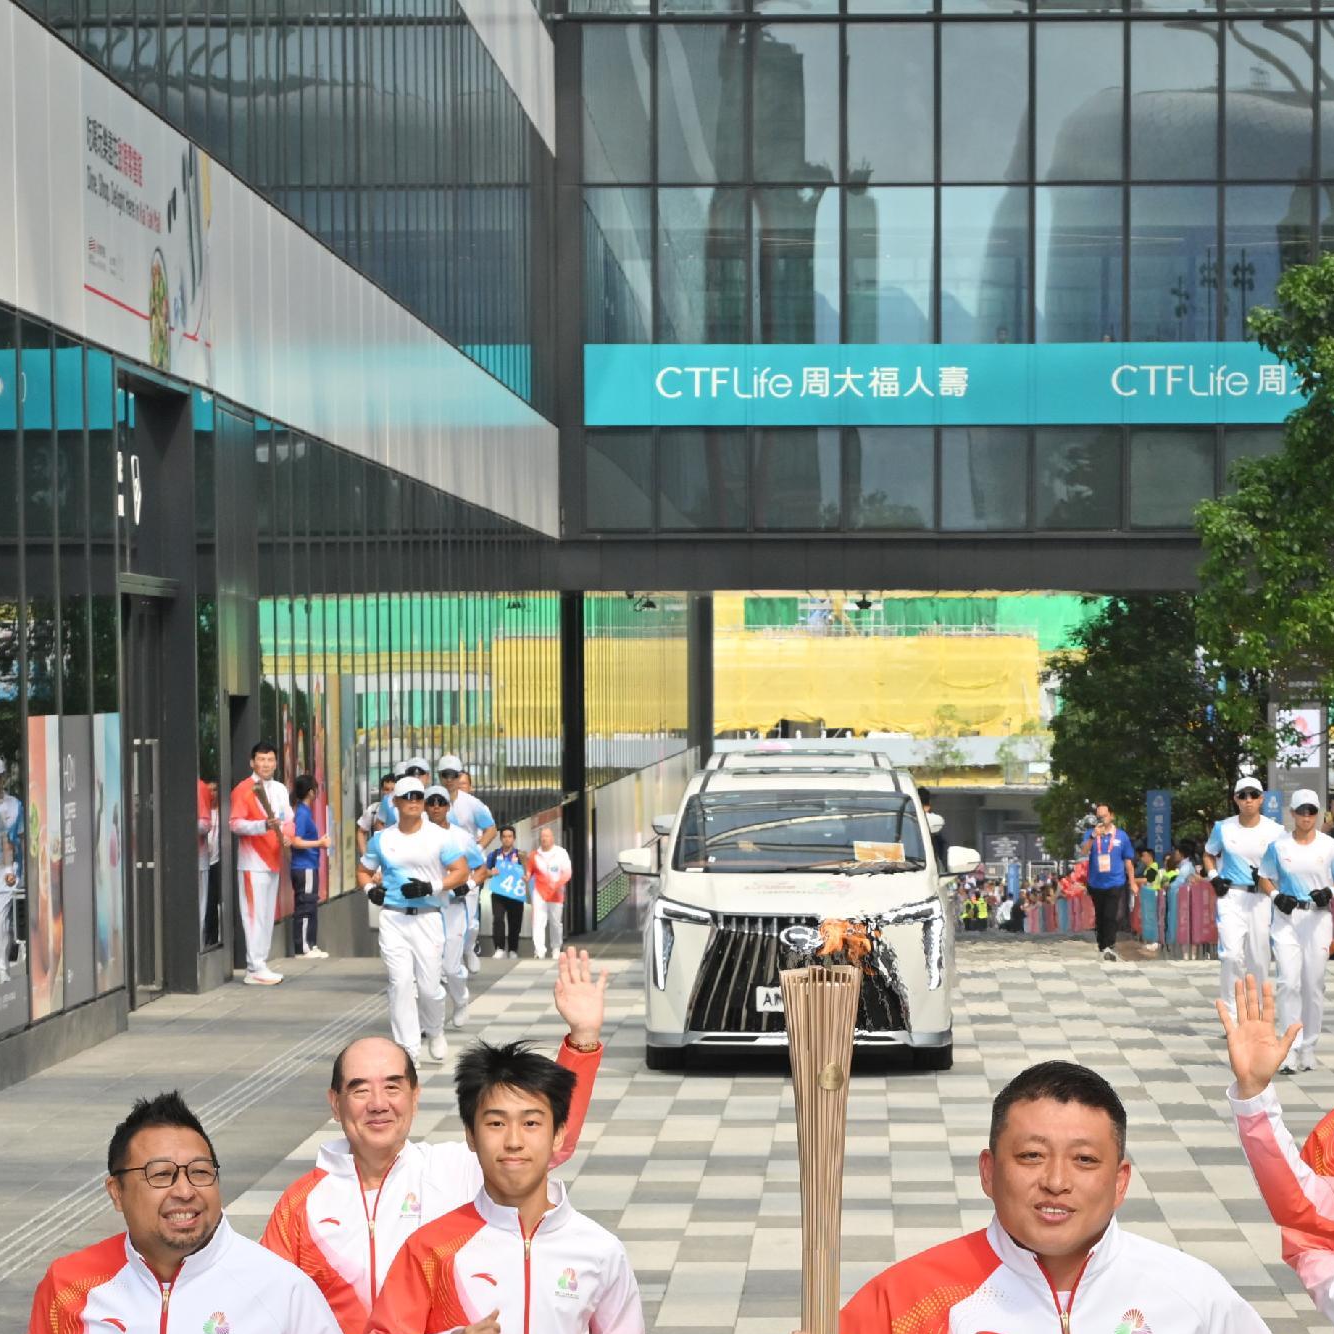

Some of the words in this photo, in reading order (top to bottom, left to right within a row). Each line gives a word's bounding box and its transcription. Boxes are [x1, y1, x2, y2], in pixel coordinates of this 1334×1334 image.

[655, 366, 794, 399] CTFLife
[799, 366, 969, 398] 周大福人壽
[1111, 364, 1250, 397] CTFLife
[500, 875, 527, 897] 48
